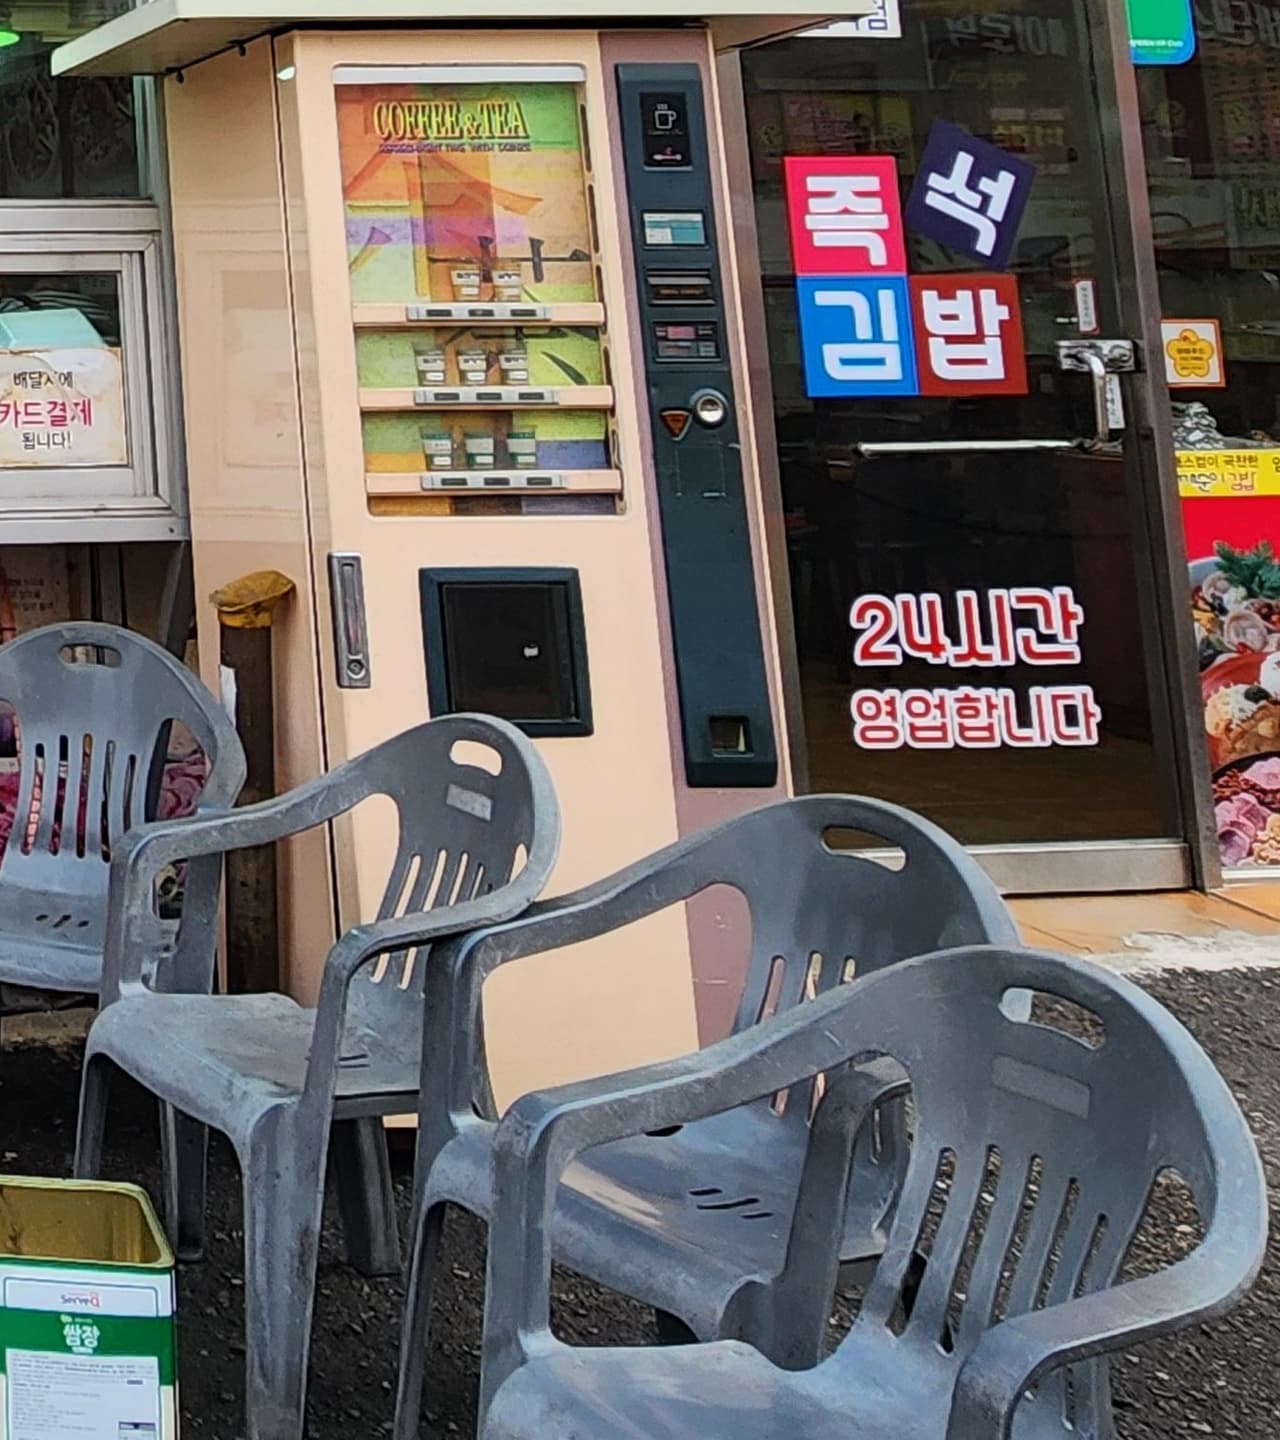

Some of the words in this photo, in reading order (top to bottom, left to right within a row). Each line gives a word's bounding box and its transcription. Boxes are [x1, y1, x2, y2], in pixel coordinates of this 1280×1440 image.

[814, 289, 1011, 381] 김밥
[21, 431, 72, 451] 됩니다!
[851, 586, 1083, 667] 24시간
[851, 685, 1102, 749] 영업합니다
